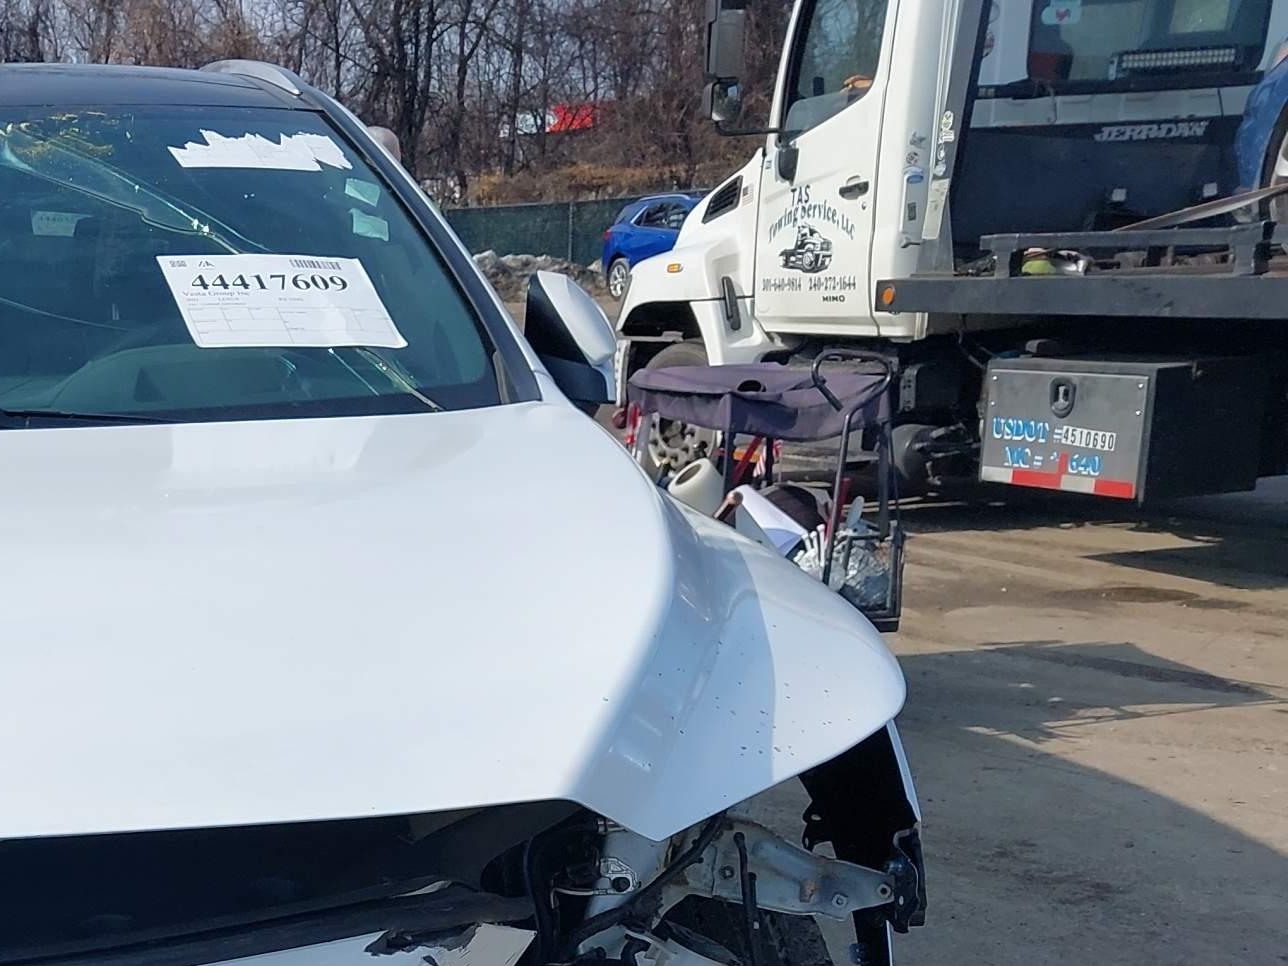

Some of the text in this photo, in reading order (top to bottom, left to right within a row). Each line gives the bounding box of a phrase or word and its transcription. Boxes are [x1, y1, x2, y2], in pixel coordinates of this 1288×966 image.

[790, 185, 810, 206] TAS
[191, 273, 348, 292] 44417609
[992, 416, 1049, 443] USDOT
